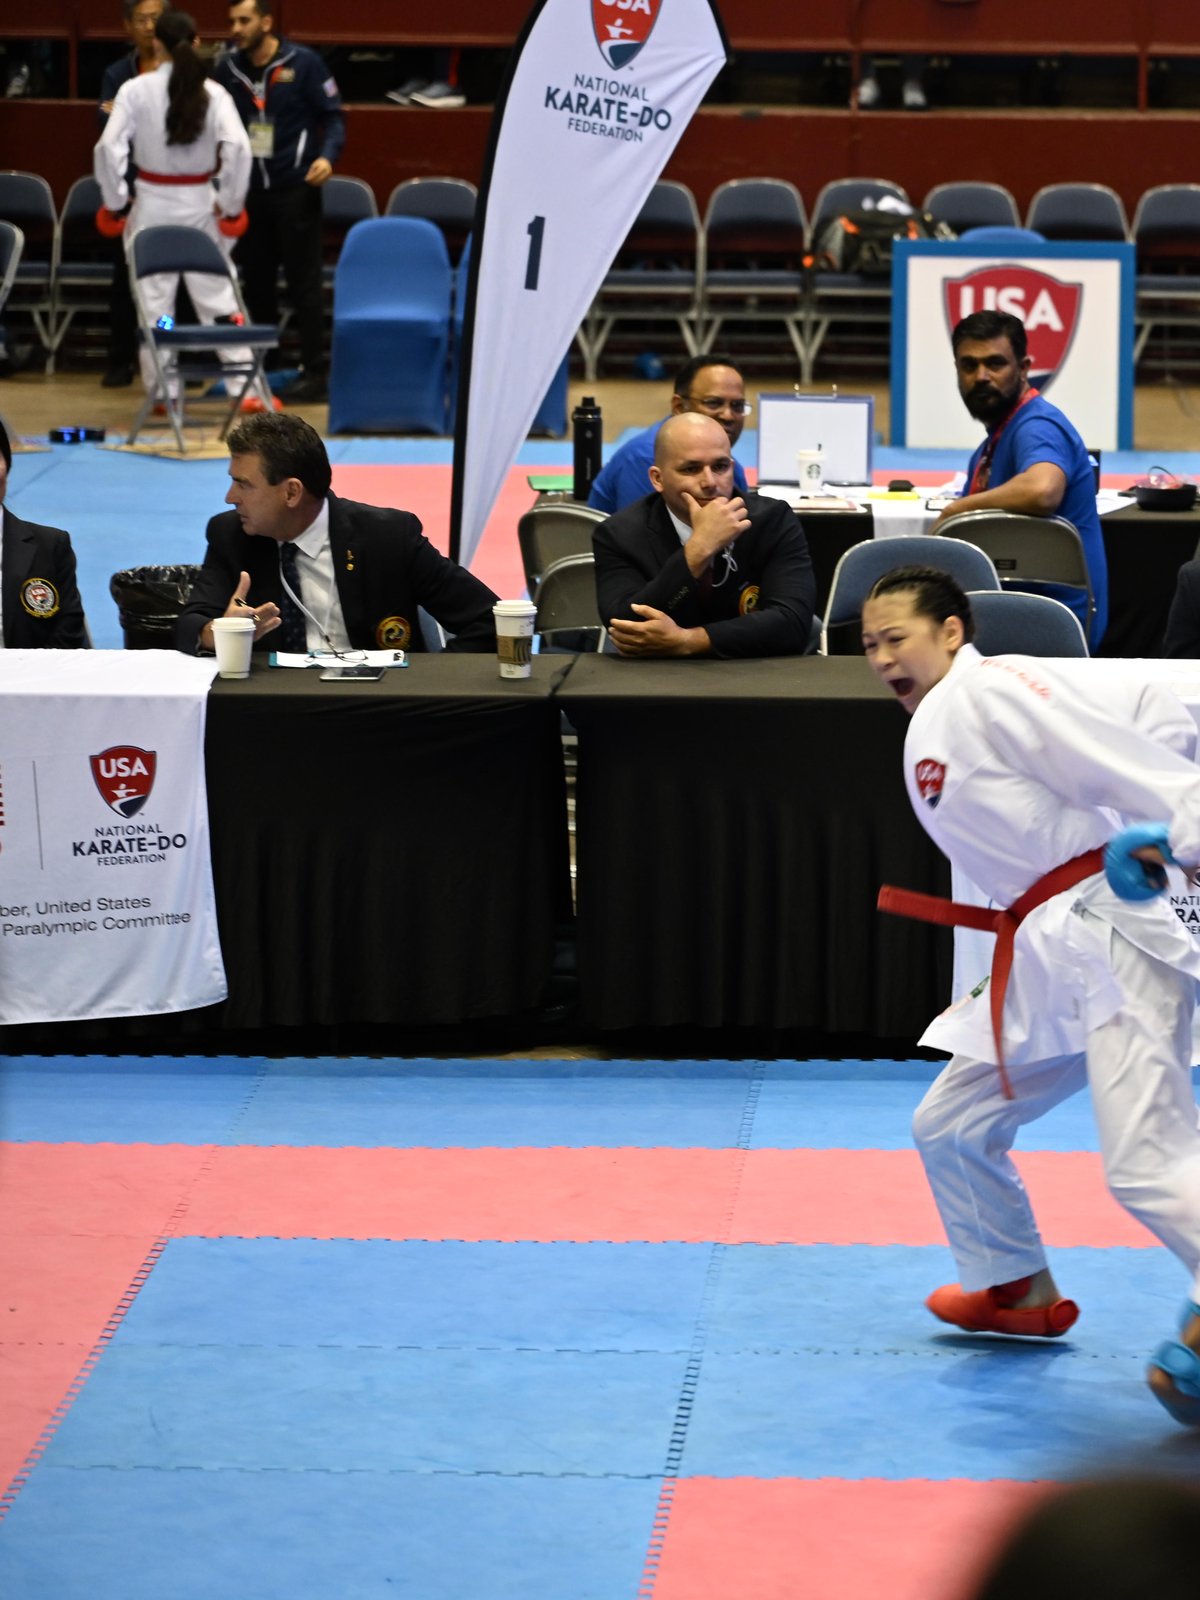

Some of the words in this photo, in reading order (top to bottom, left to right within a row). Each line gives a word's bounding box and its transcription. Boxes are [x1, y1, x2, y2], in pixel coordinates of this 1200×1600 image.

[573, 73, 650, 102] NATIONAL
[544, 86, 672, 131] KARATE-DO
[567, 117, 644, 143] FEDERATION
[524, 215, 546, 291] 1
[960, 285, 1065, 332] USA
[99, 757, 150, 779] USA
[94, 823, 164, 838] NATIONAL
[72, 833, 187, 857] KARATE-DO
[97, 853, 167, 867] FEDERATION
[35, 898, 92, 916] United
[96, 896, 152, 911] States
[2, 918, 98, 937] Paralympic
[102, 911, 192, 931] Committee
